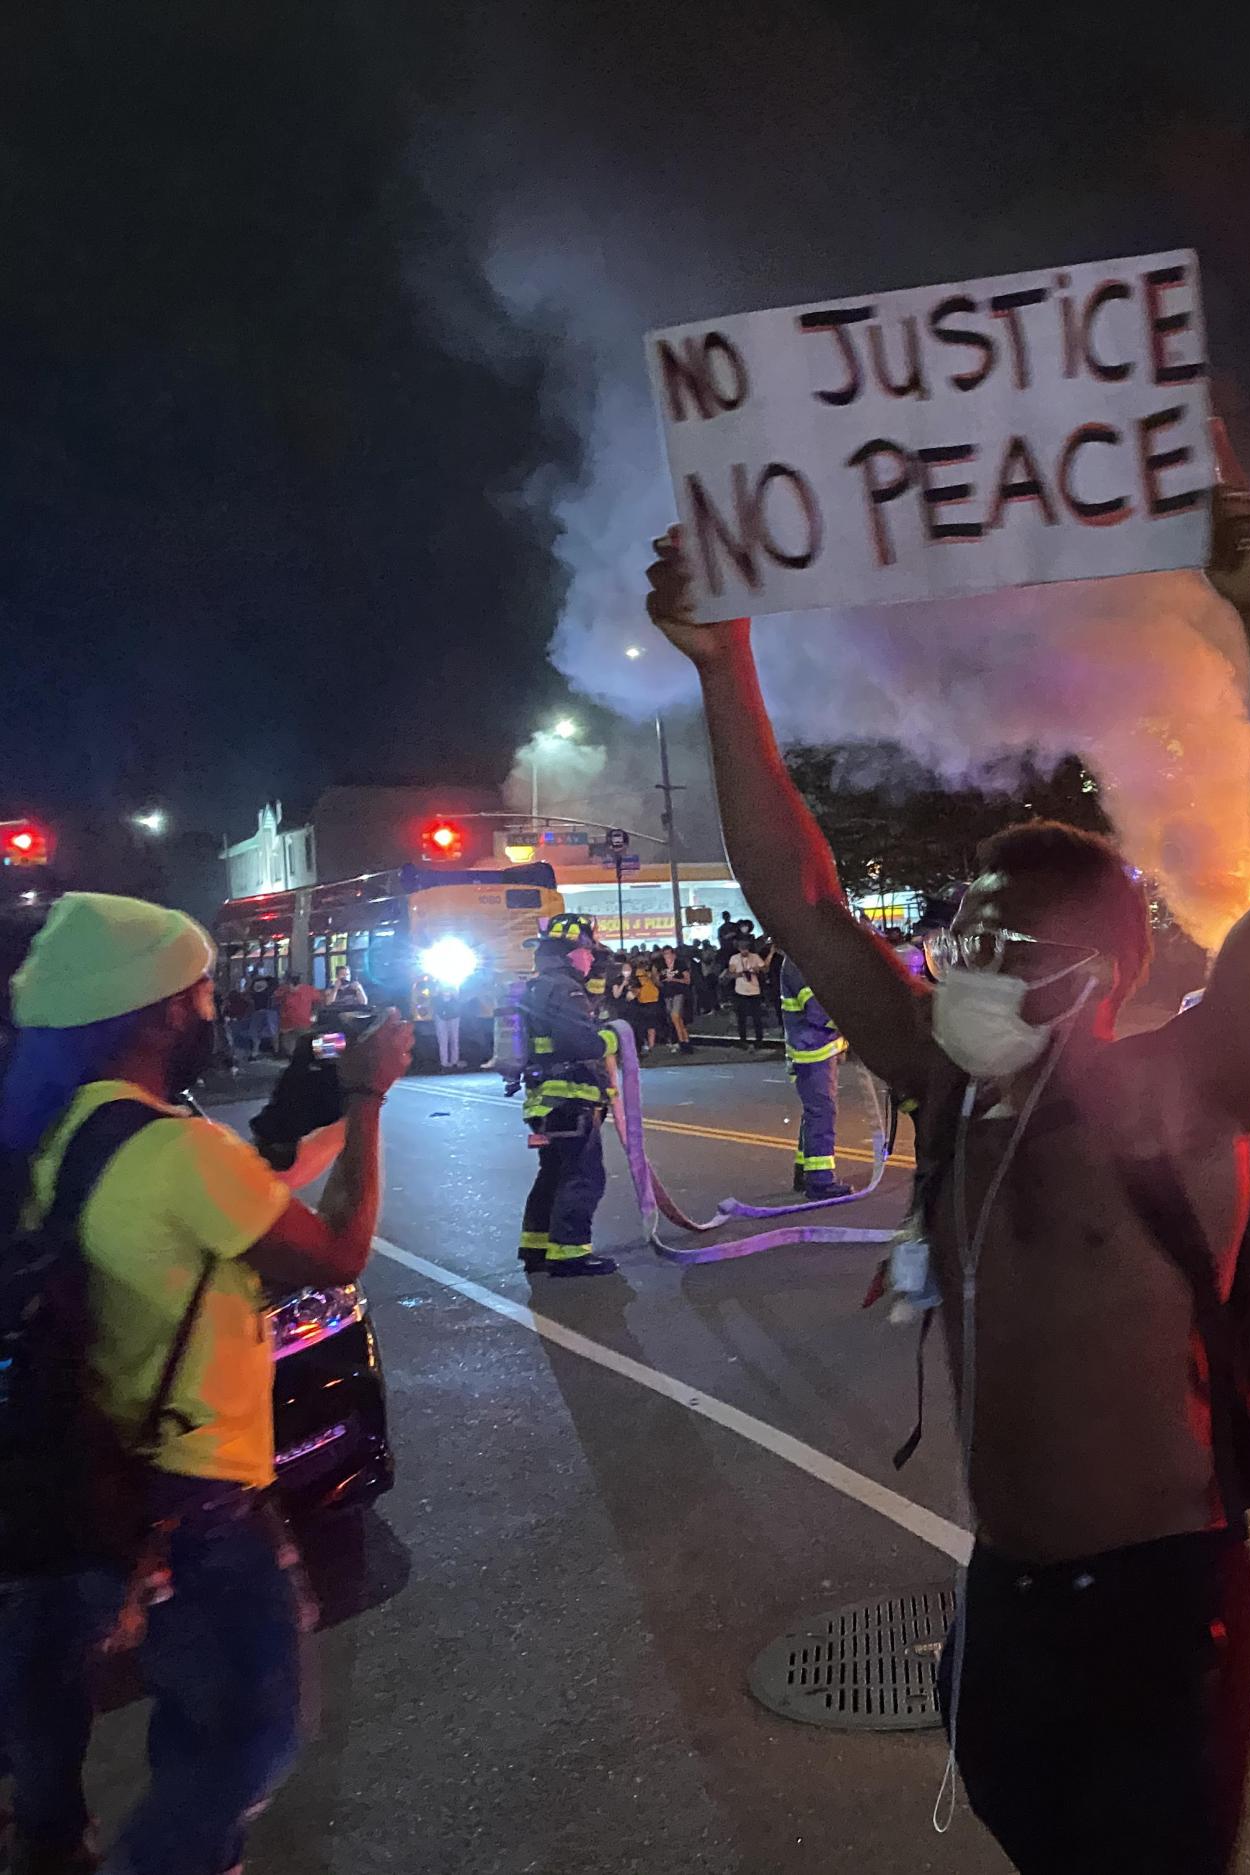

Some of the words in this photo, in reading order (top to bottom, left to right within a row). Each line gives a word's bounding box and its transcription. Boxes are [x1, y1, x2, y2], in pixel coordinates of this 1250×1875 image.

[655, 330, 750, 422] NO
[684, 461, 823, 598] NO
[846, 404, 1206, 566] PEACE
